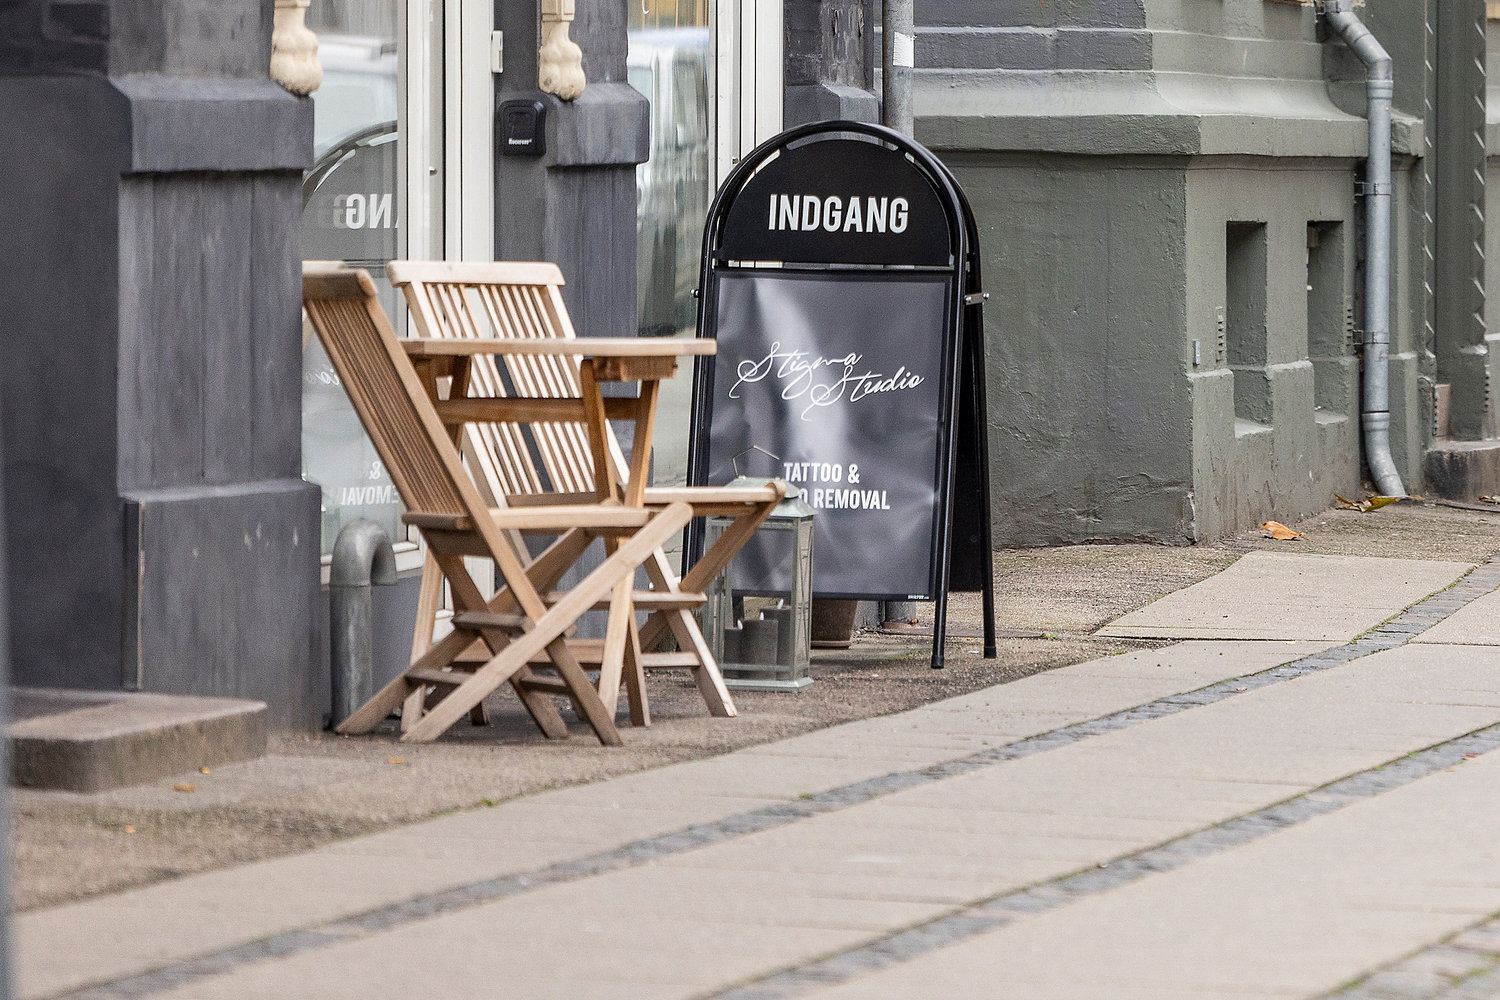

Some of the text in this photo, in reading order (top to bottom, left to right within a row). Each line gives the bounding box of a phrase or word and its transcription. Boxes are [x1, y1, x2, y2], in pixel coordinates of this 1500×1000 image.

[768, 194, 909, 233] INDGANG
[728, 341, 862, 400] Stigma
[801, 365, 924, 421] Studio
[783, 462, 860, 484] TATTOO &
[813, 488, 890, 510] REMOVAL
